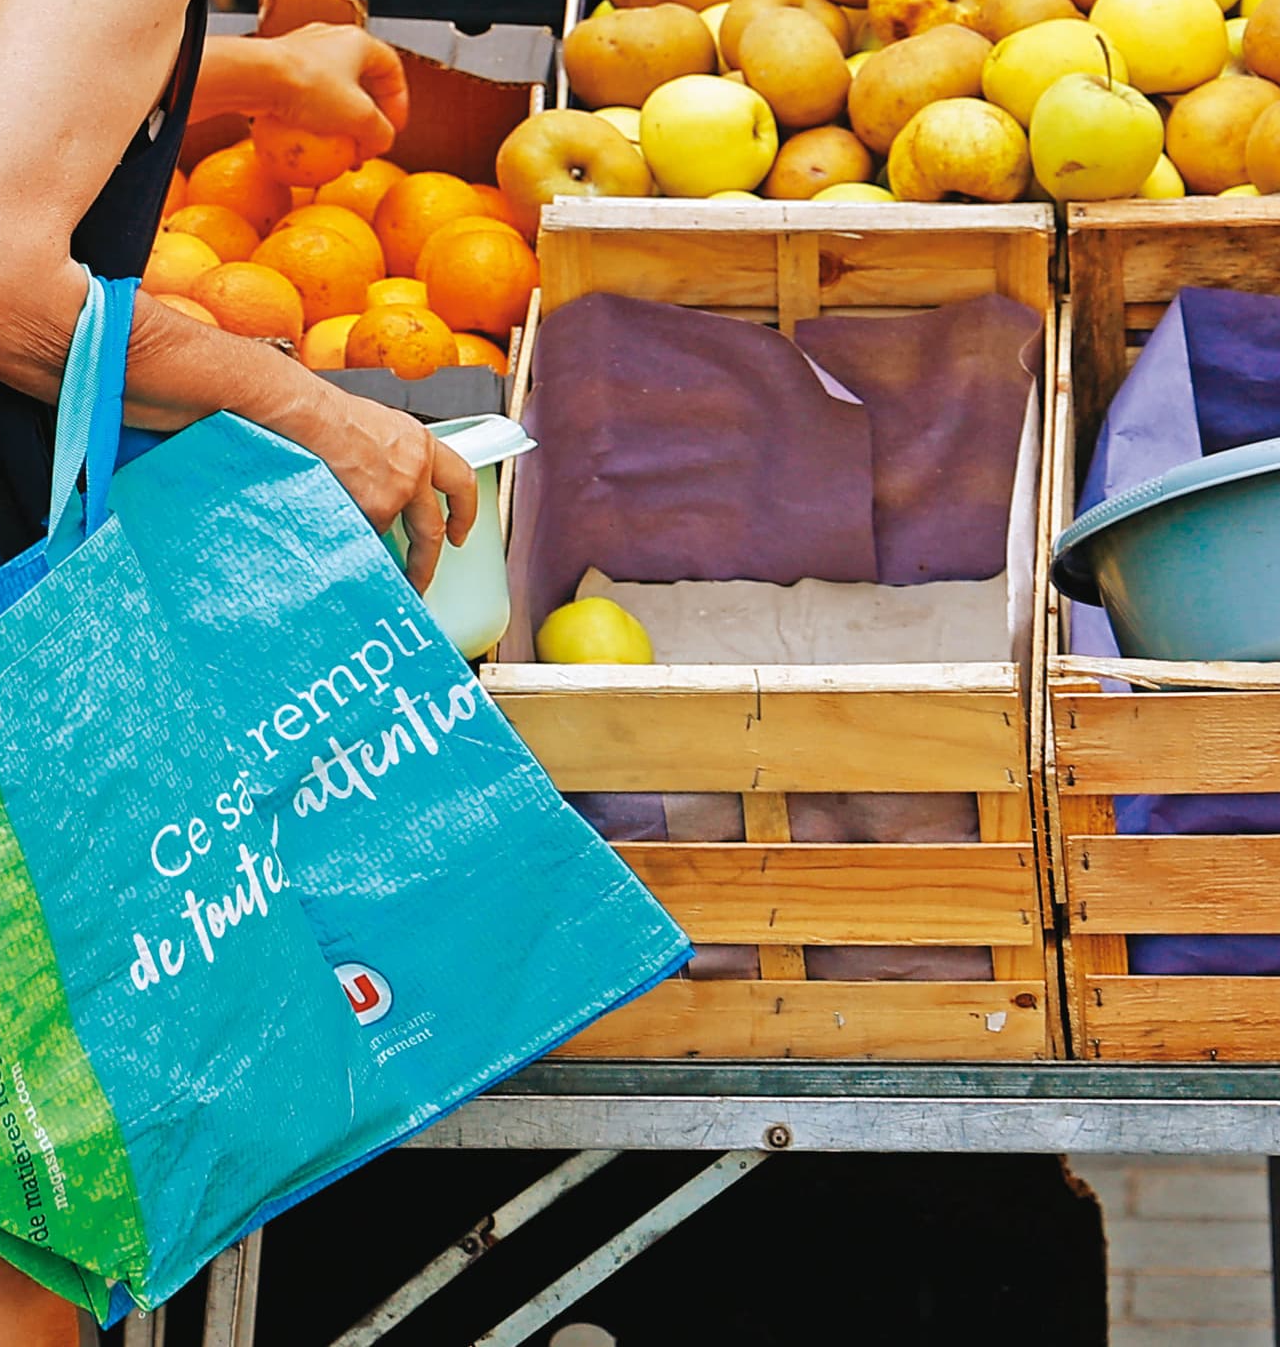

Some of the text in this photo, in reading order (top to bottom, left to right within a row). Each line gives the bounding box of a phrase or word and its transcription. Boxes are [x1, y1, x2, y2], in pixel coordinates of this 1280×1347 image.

[151, 818, 212, 877] Ce
[246, 607, 434, 762] rempli
[129, 933, 186, 992] de
[293, 677, 477, 818] attentio
[375, 1027, 434, 1068] rement
[2, 1112, 43, 1212] matières
[12, 1061, 69, 1210] magasins-u.com
[29, 1213, 50, 1243] de
